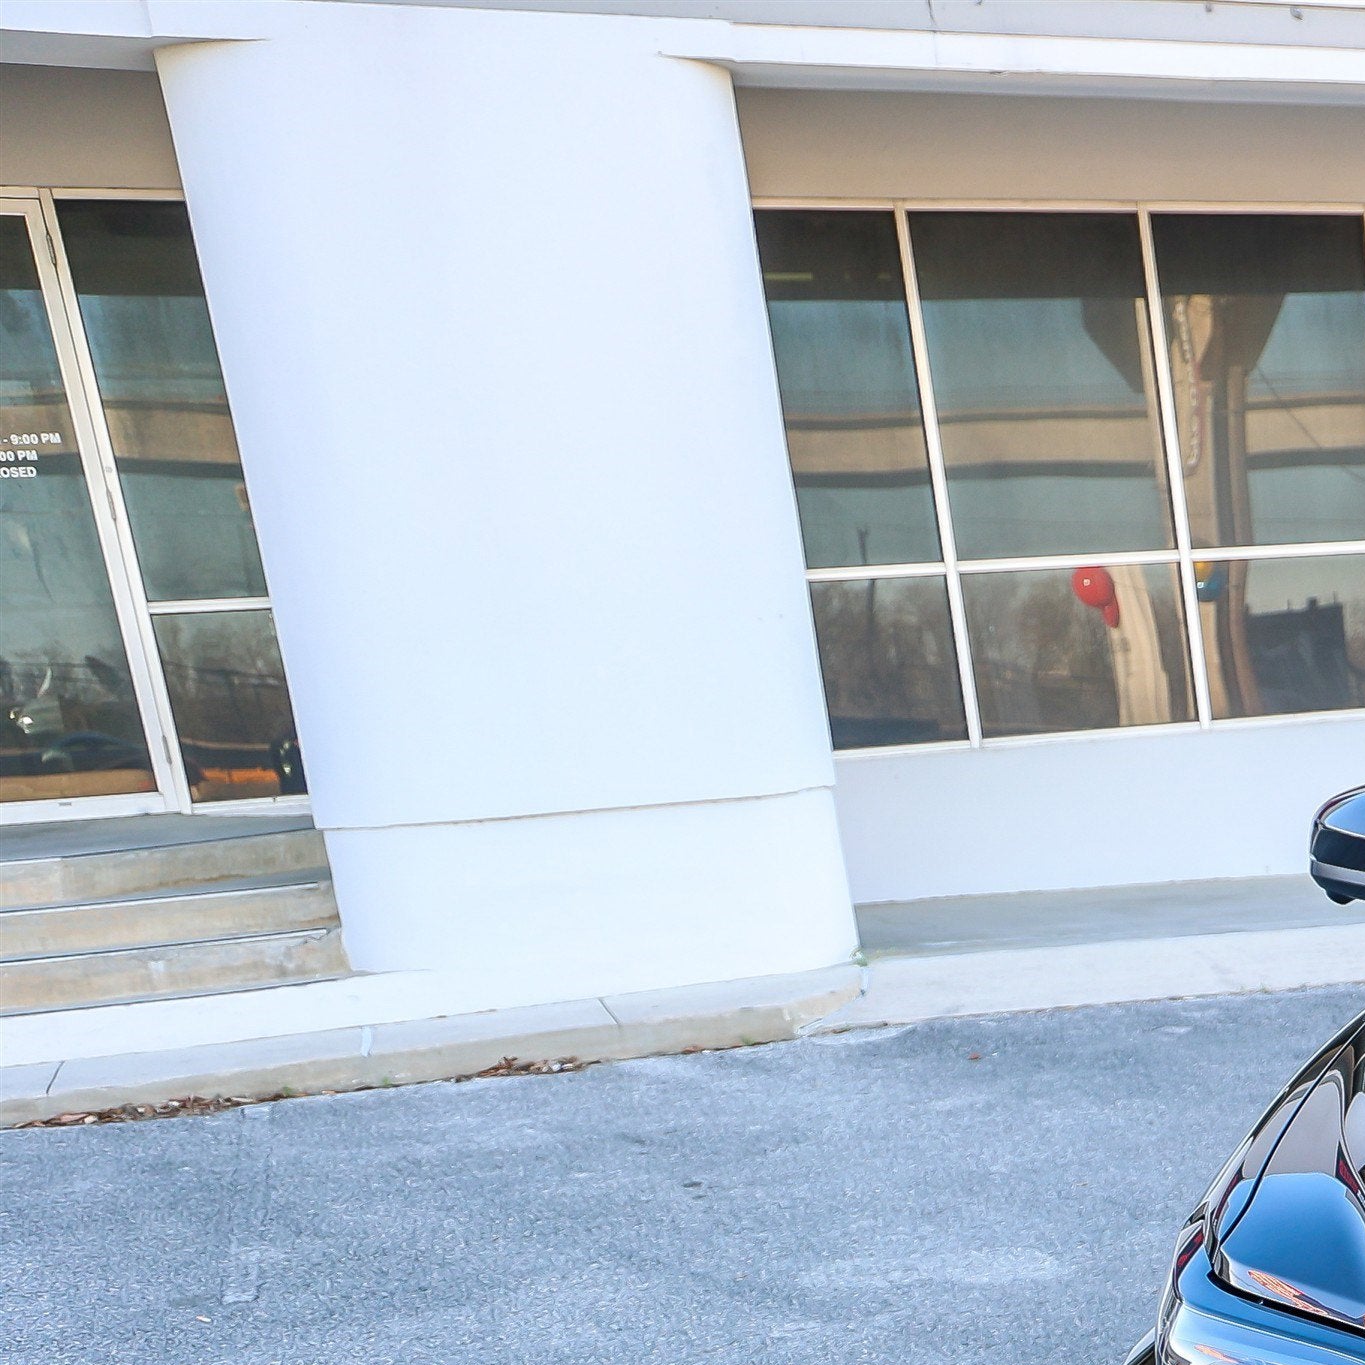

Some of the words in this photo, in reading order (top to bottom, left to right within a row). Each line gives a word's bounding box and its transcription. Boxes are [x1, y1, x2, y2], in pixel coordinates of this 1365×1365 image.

[10, 433, 39, 444] 9:00
[40, 432, 61, 444] PM
[17, 450, 38, 461] PM
[0, 466, 37, 478] OSED
